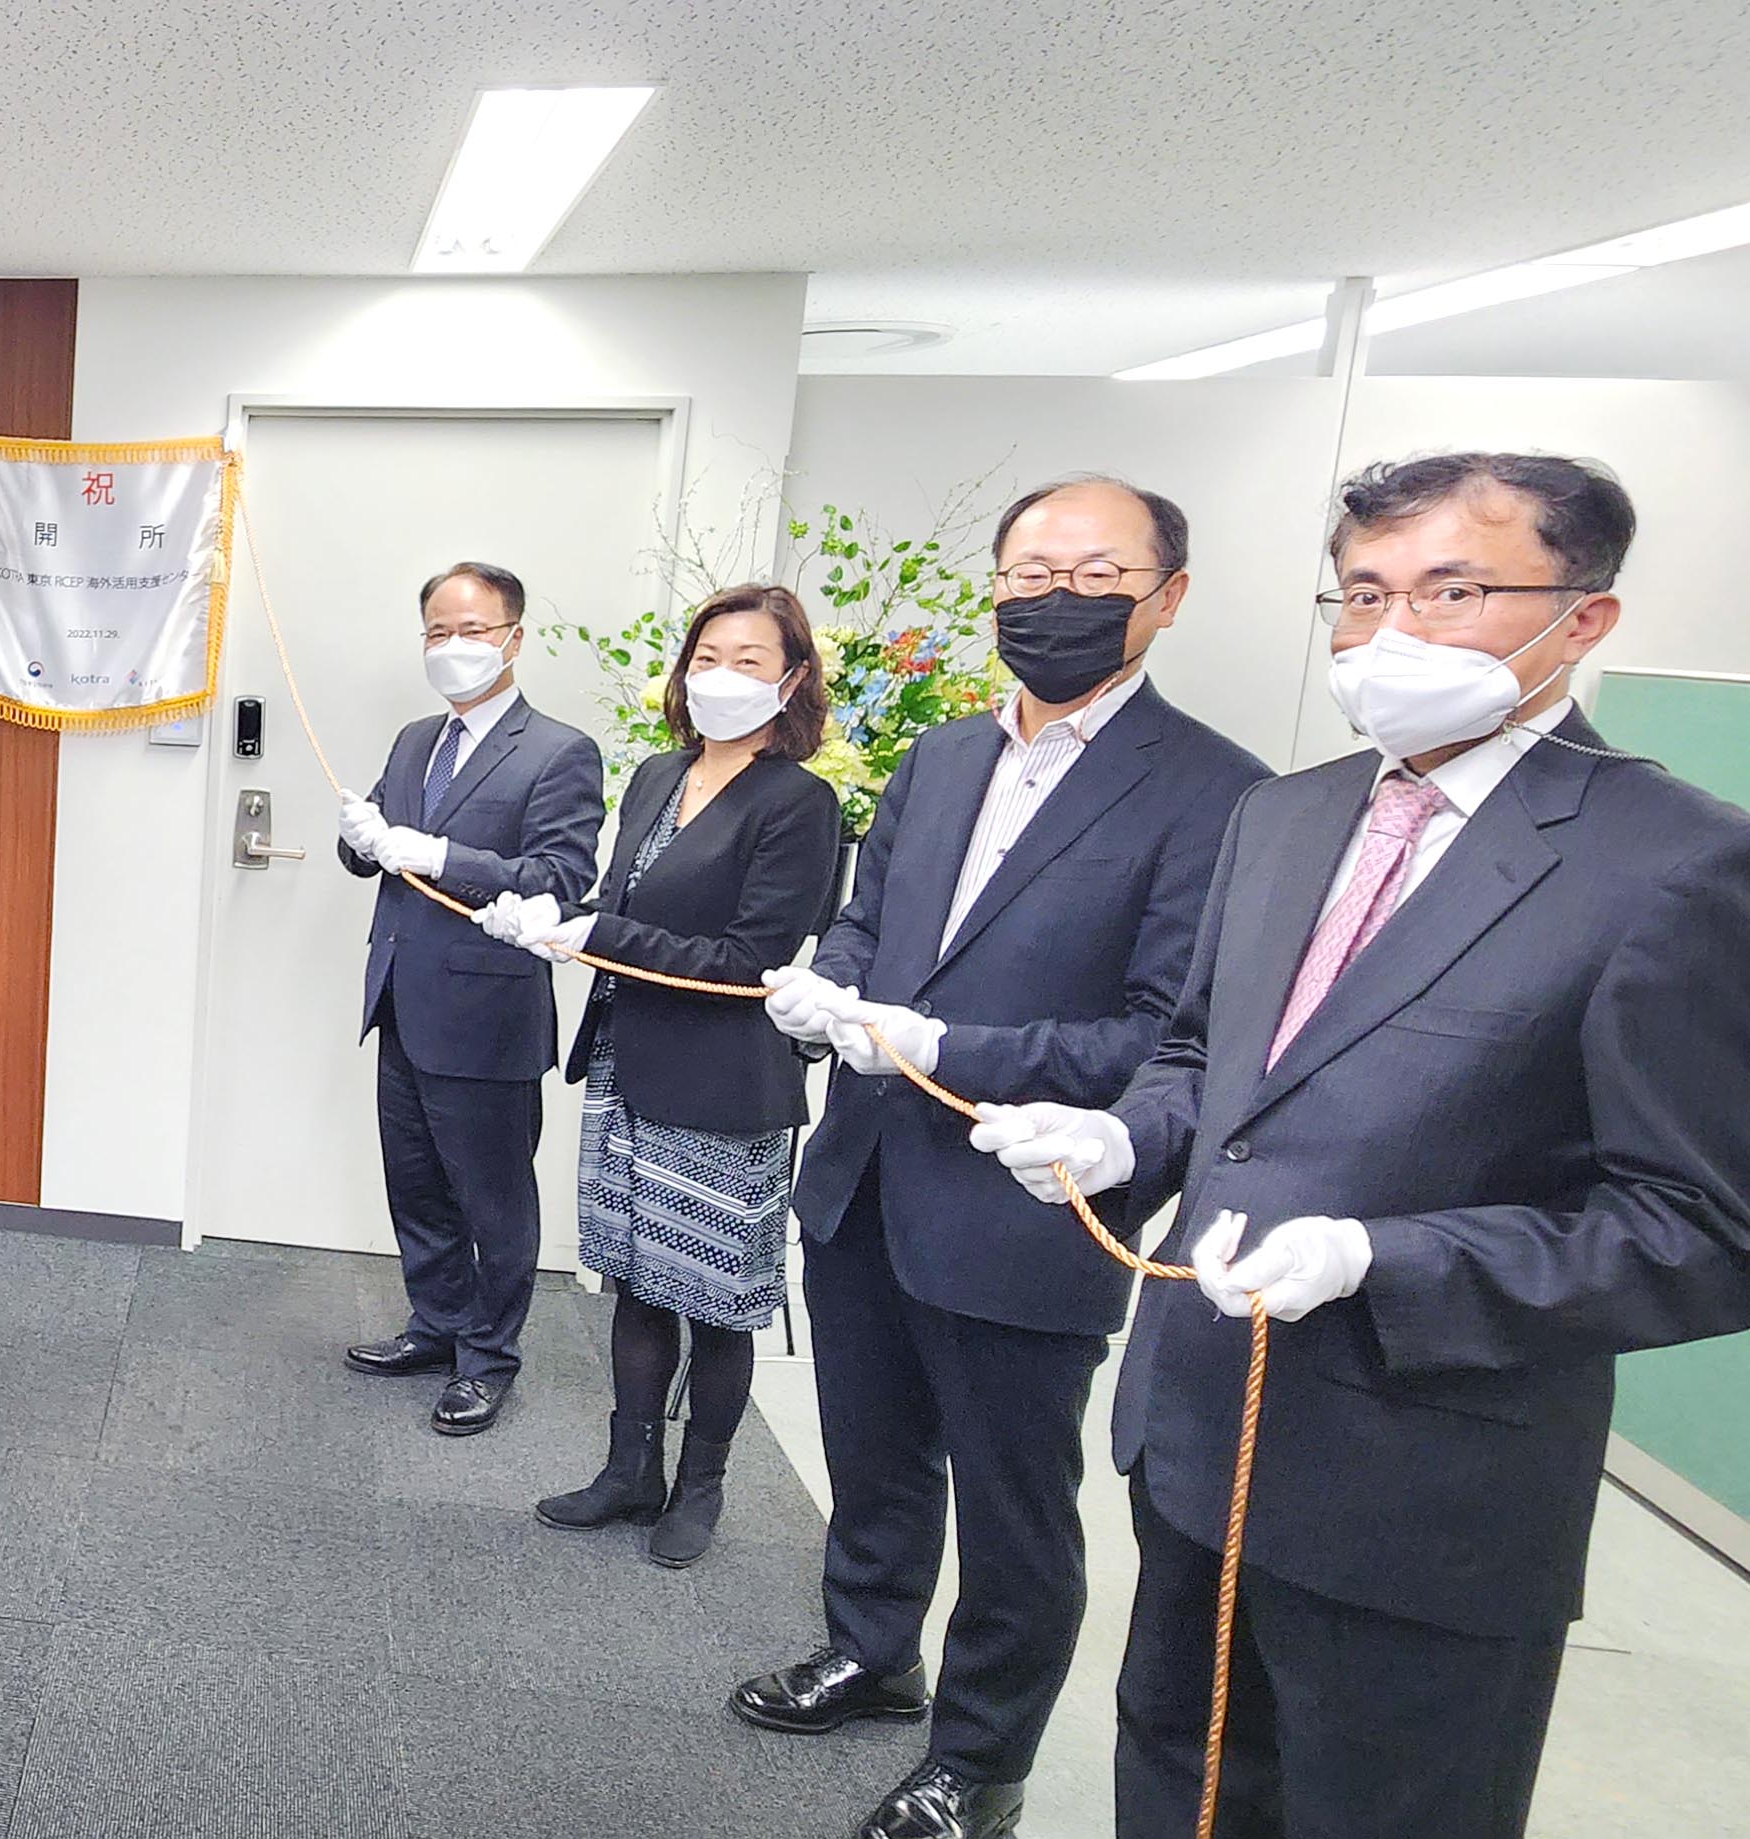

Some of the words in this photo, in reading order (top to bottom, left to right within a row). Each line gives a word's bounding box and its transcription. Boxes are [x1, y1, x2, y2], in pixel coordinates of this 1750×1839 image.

[81, 471, 115, 506] 祝
[33, 521, 58, 547] 開
[138, 523, 167, 550] 所
[26, 573, 52, 588] 東京
[54, 576, 84, 588] RCEP
[70, 673, 111, 686] kotra
